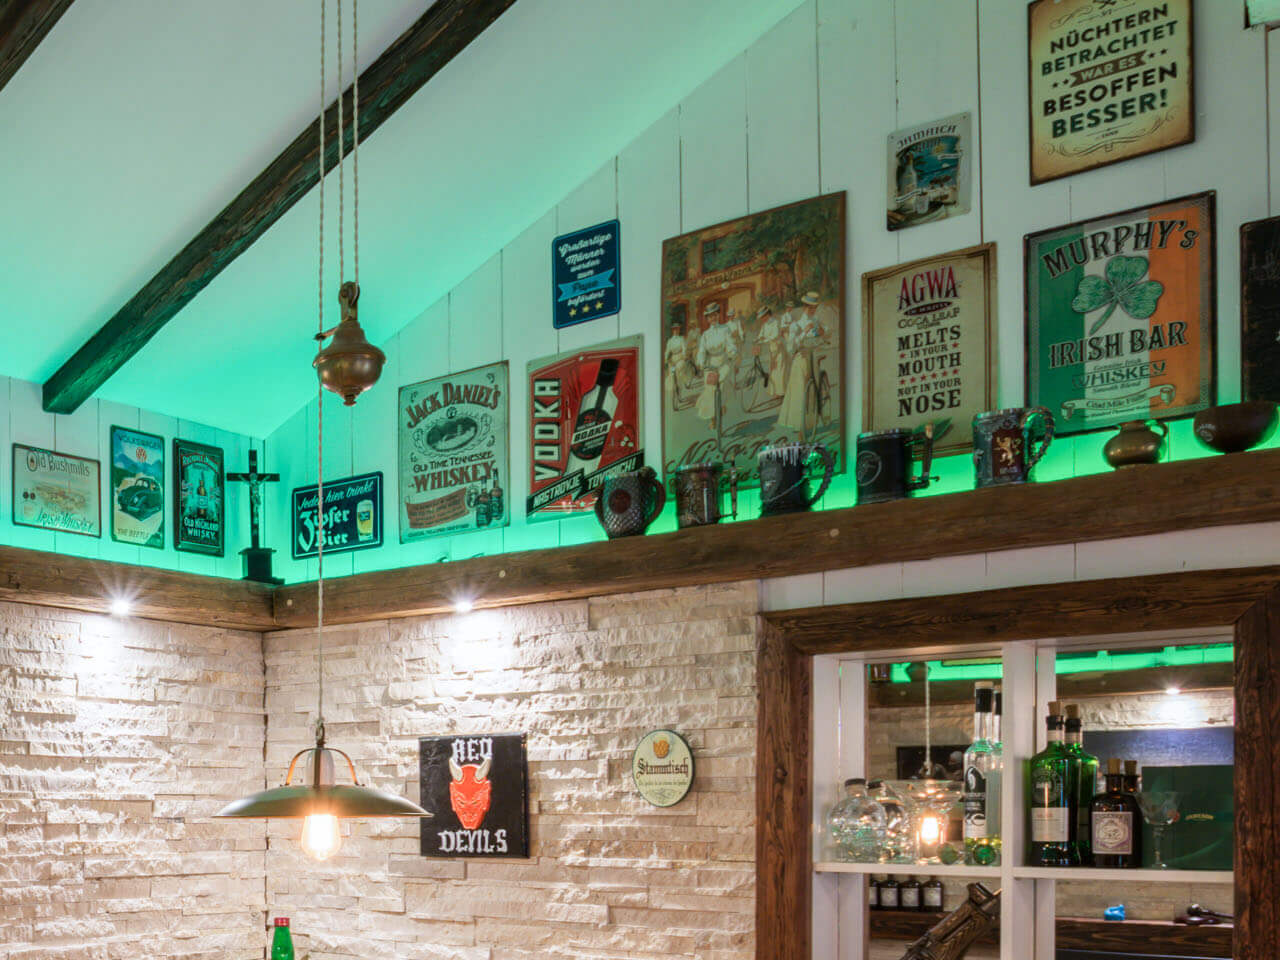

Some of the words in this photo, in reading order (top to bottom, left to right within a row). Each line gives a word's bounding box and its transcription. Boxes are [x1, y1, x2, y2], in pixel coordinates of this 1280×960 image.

[1050, 3, 1168, 53] NÜCHTERN
[1042, 20, 1178, 76] BETRACHTET
[1081, 64, 1114, 80] WAR
[1118, 55, 1138, 69] ES
[1043, 62, 1177, 117] BESOFFEN
[1052, 89, 1168, 138] BESSER!
[897, 265, 959, 310] AGWA
[897, 325, 961, 351] MELTS
[910, 349, 920, 358] IN
[922, 344, 948, 356] YOUR
[1048, 332, 1125, 369] IRISH
[1130, 321, 1188, 354] BAR
[898, 352, 961, 377] MOUTH
[897, 386, 918, 397] NOT
[920, 383, 930, 393] IN
[933, 377, 961, 390] YOUR
[406, 391, 442, 428] JACK
[442, 382, 501, 410] DANIEL'S
[897, 389, 961, 417] NOSE
[534, 378, 562, 483] VODKA
[26, 451, 47, 472] Old
[48, 454, 90, 477] Bushmills
[414, 459, 496, 493] WHISKEY
[451, 737, 493, 762] RED
[437, 829, 507, 853] DEVILS
